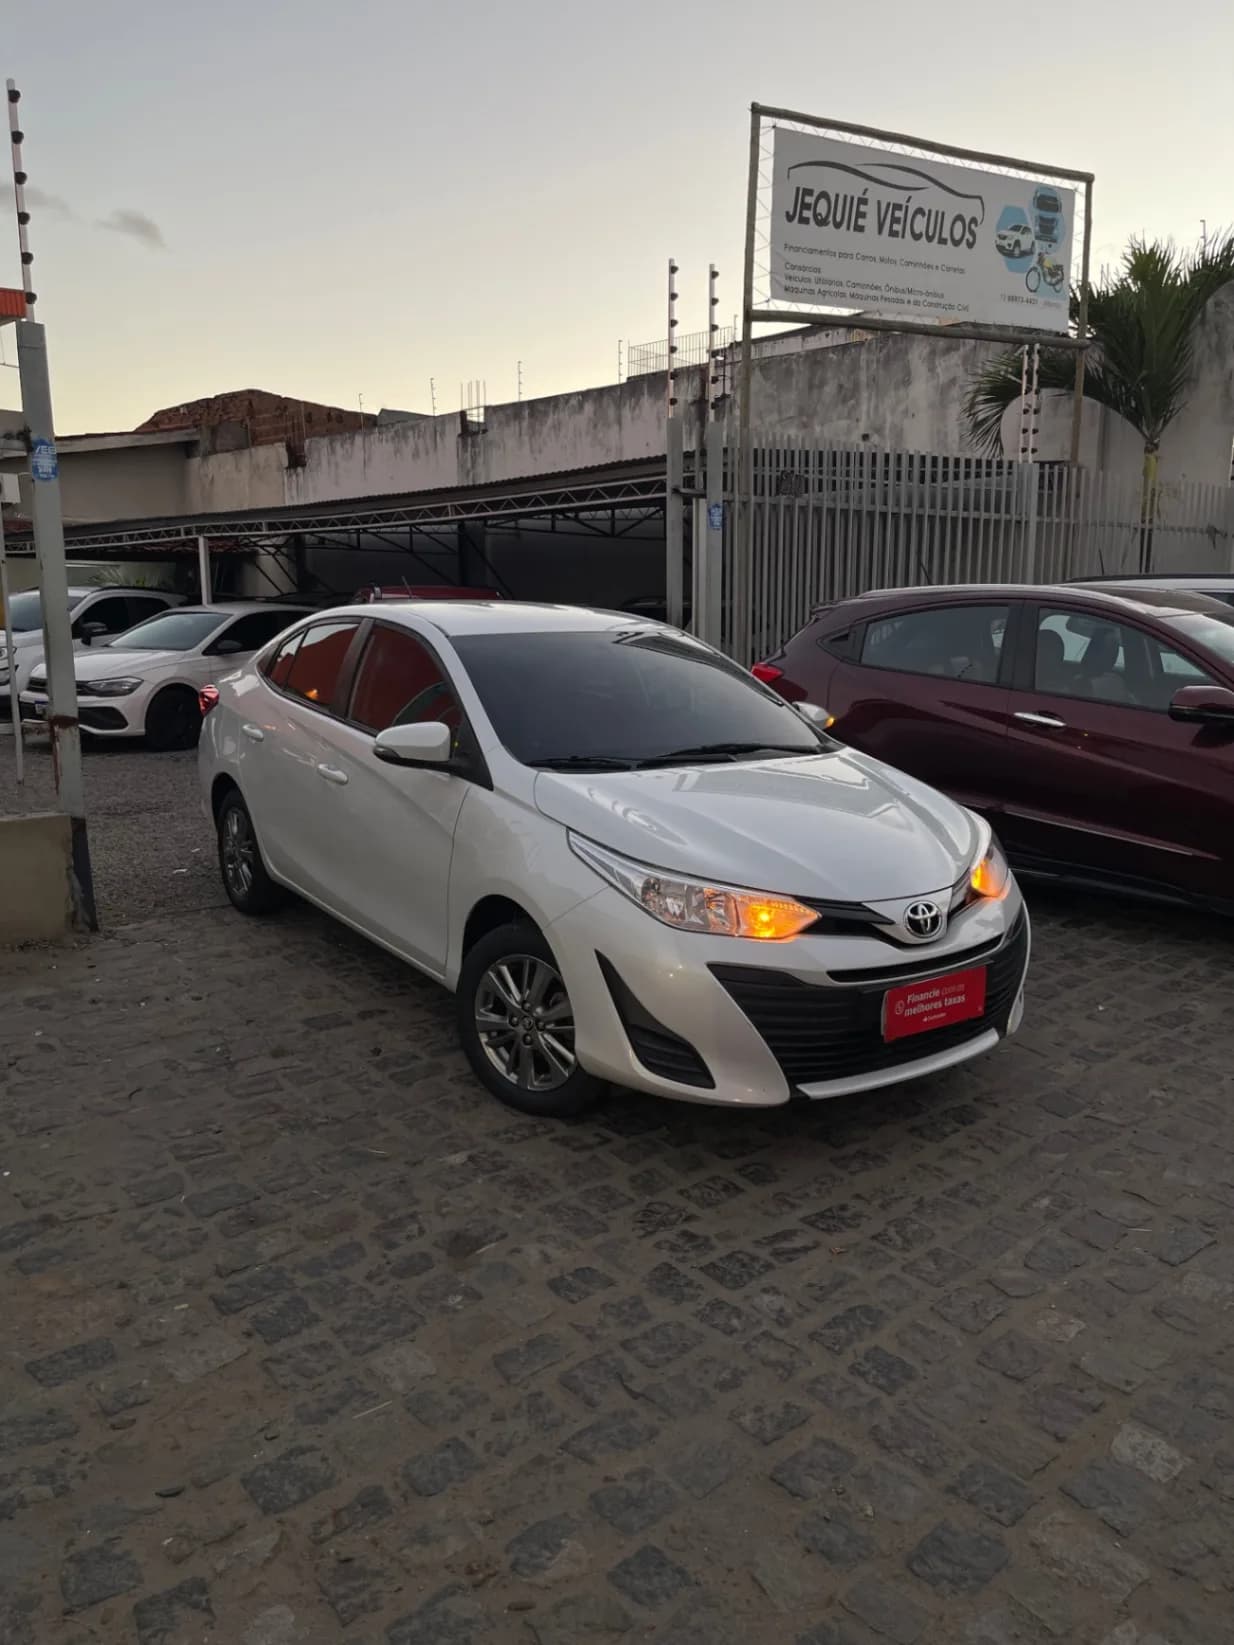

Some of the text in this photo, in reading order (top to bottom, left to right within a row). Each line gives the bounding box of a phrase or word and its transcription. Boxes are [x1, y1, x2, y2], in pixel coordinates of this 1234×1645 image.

[785, 187, 978, 249] JEQUIÉ VEÍCULOS
[784, 243, 836, 258] Financiamentos
[838, 251, 854, 260] para
[904, 1000, 942, 1017] melhores
[944, 994, 966, 1007] taxas
[907, 989, 940, 1005] Financie
